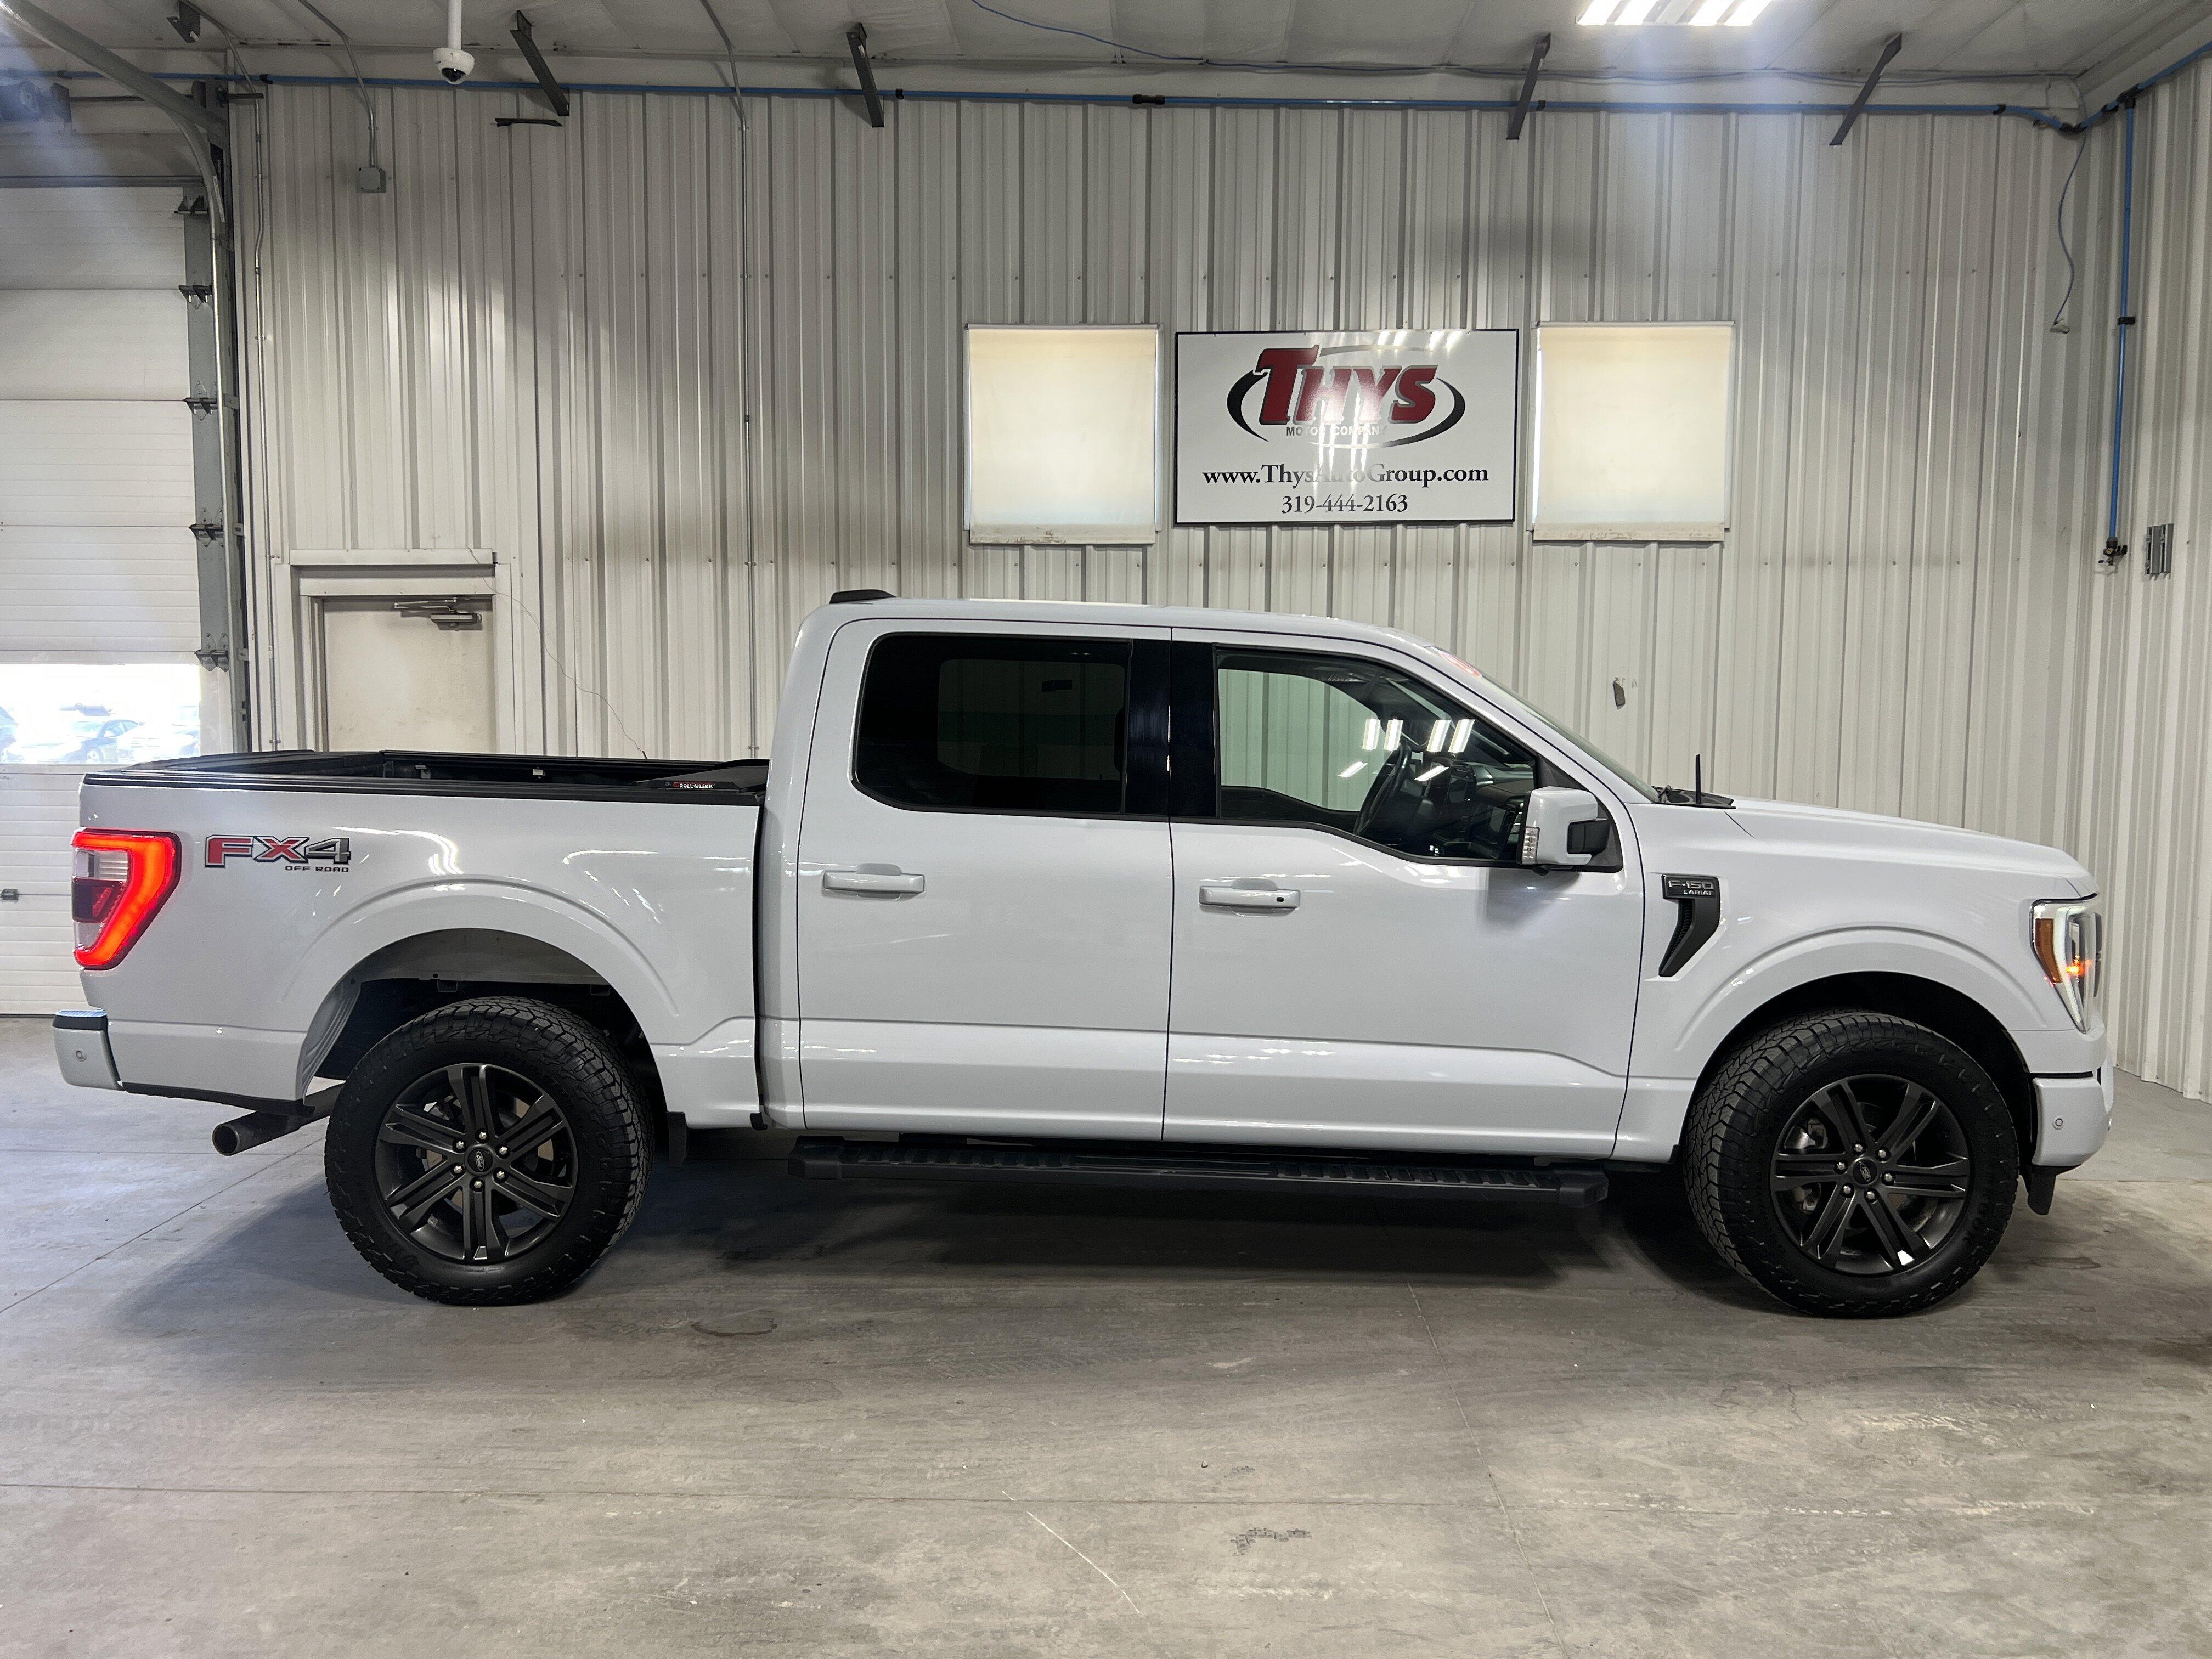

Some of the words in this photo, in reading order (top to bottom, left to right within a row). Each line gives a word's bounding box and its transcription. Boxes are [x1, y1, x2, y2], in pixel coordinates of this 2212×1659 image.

[1252, 345, 1438, 425] THYS
[1201, 464, 1489, 489] www.ThysAutoGroup.com
[1281, 493, 1408, 514] 319-444-2163
[205, 834, 351, 868] FX4
[1668, 880, 1714, 889] F-150
